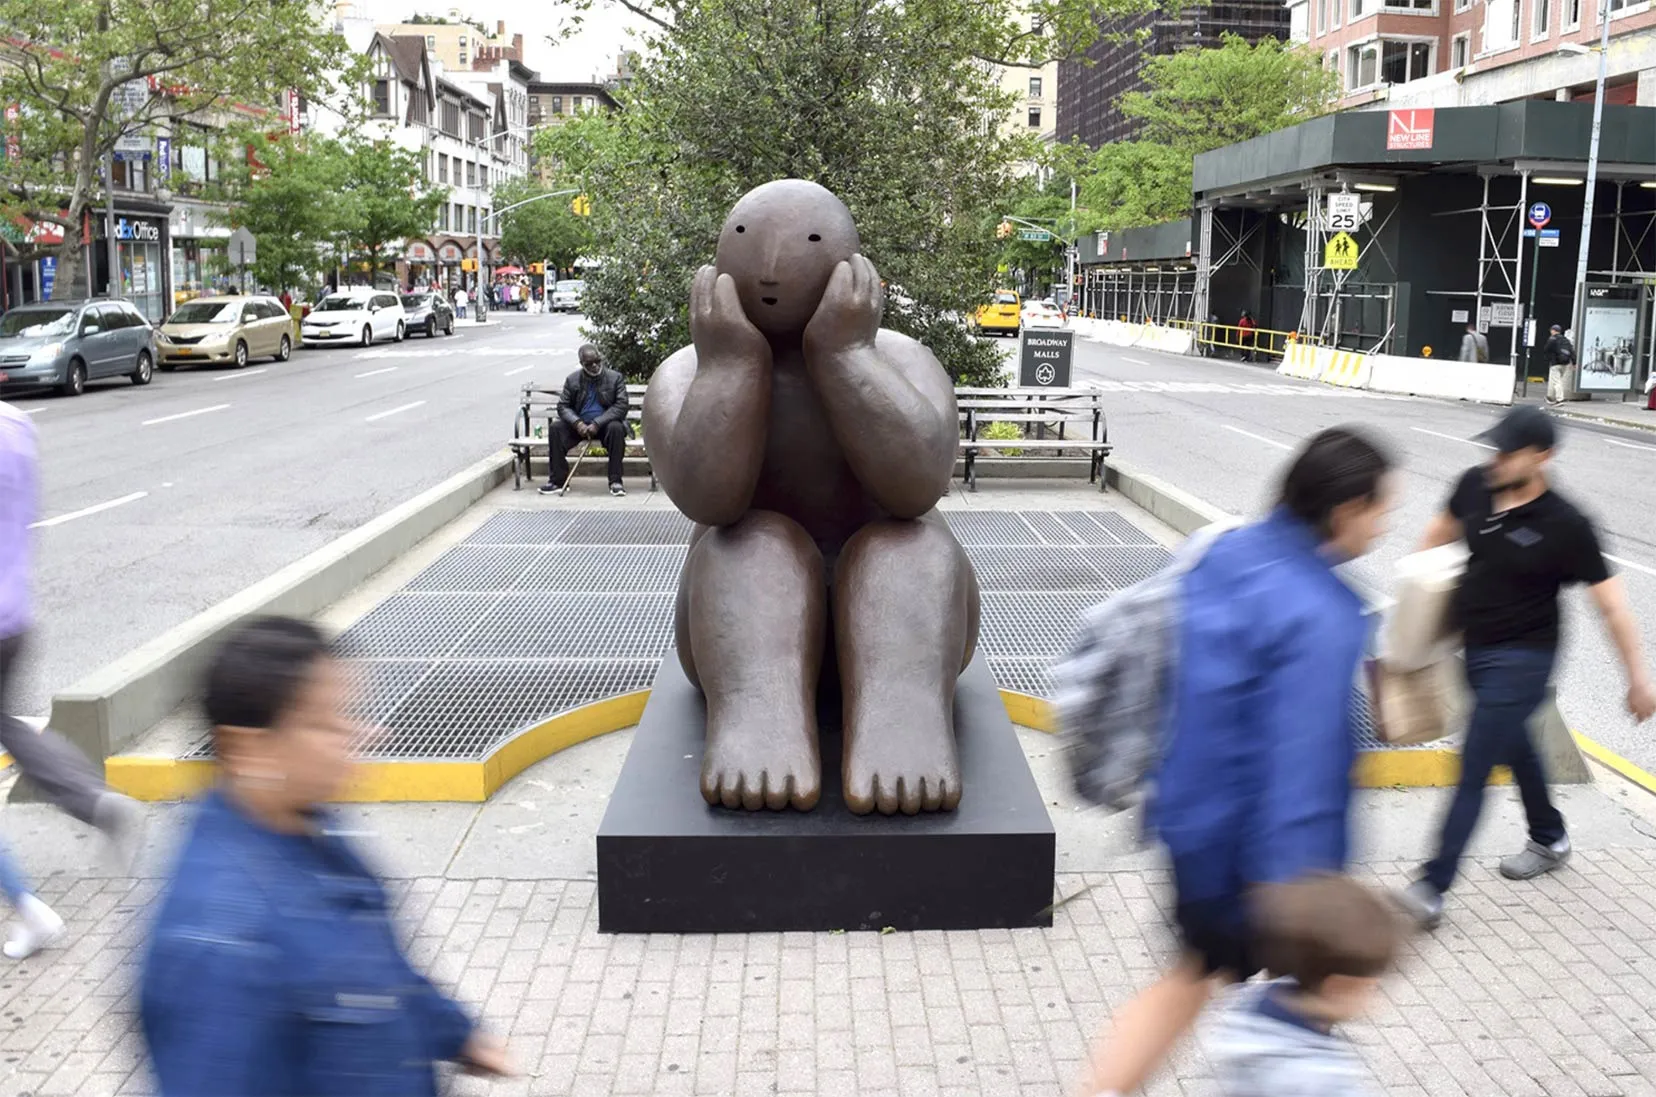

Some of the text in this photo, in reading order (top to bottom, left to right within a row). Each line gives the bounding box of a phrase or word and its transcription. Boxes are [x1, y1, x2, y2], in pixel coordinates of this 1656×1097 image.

[1390, 110, 1431, 134] NL
[1391, 133, 1430, 143] NEW LINE
[1332, 214, 1354, 228] 25
[133, 221, 159, 240] Office
[1027, 338, 1068, 346] BROADWAY
[1033, 350, 1060, 359] MALLS
